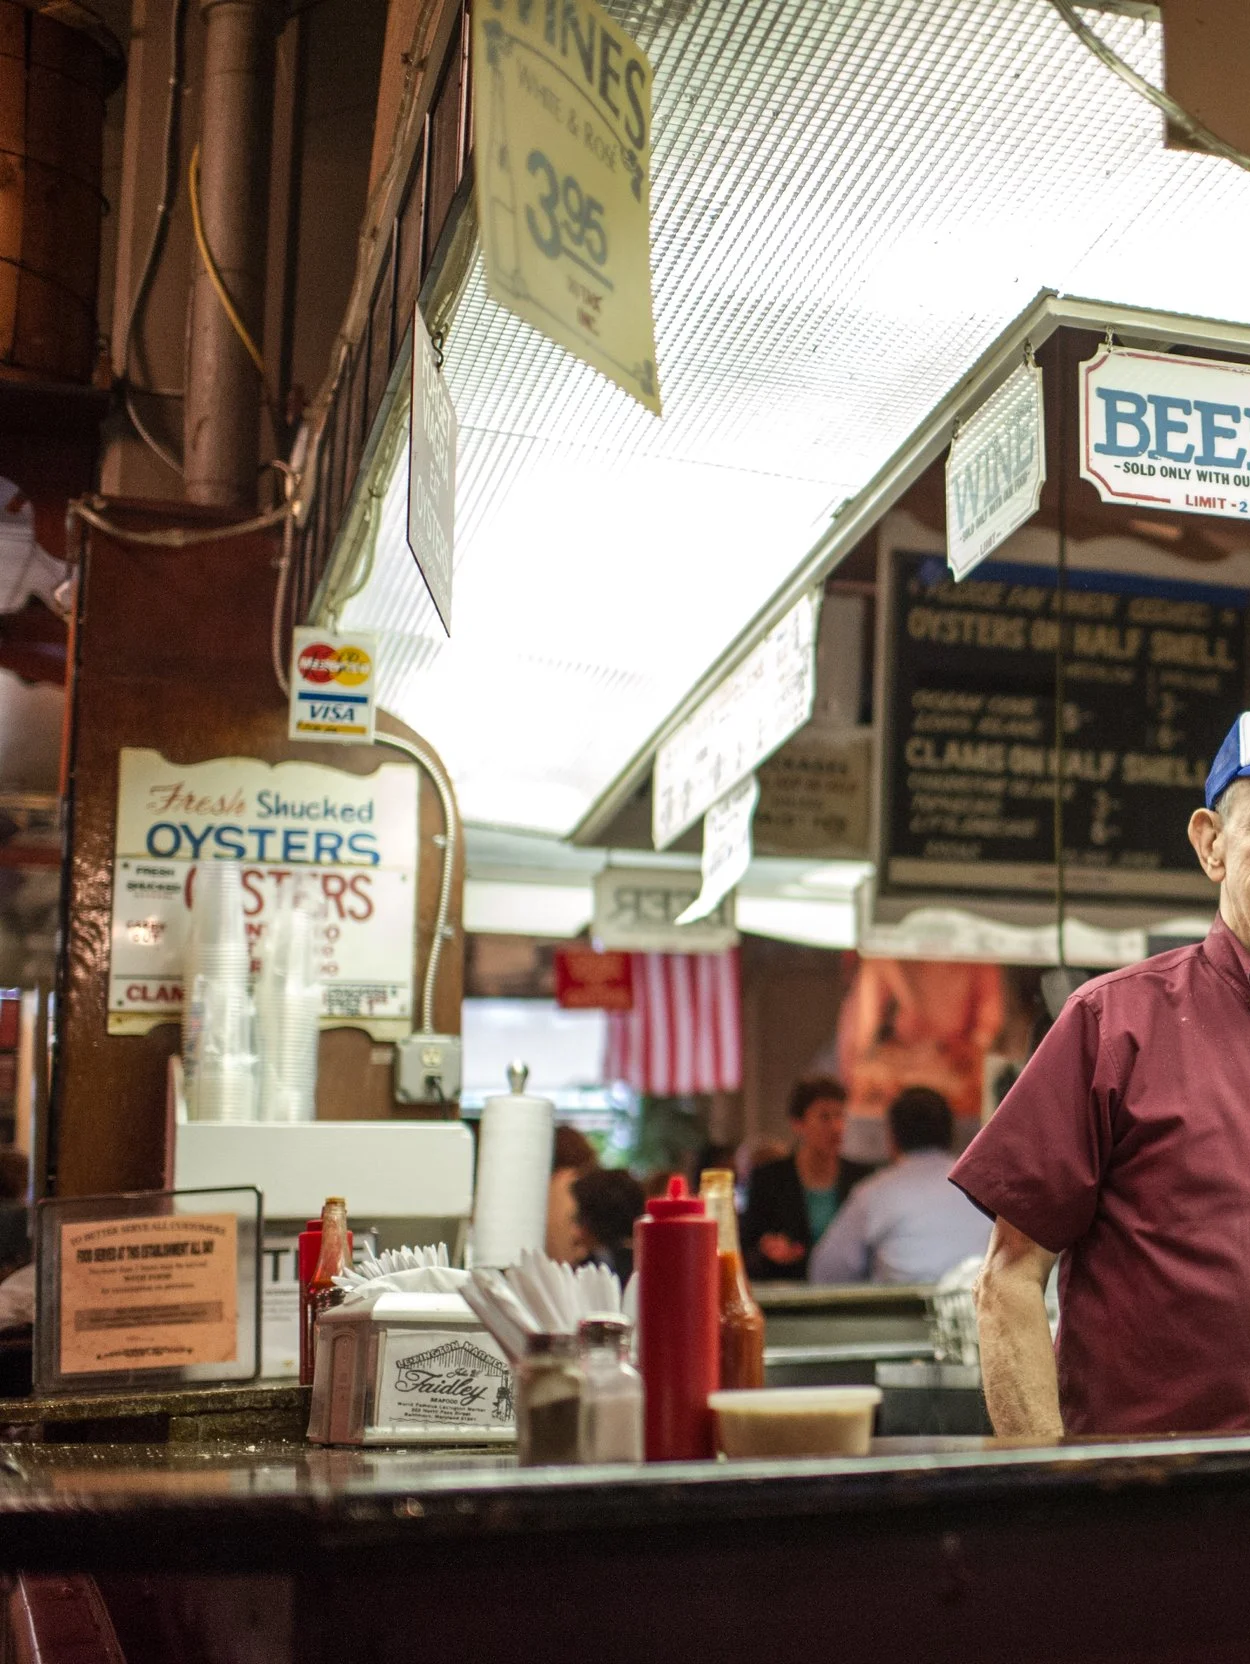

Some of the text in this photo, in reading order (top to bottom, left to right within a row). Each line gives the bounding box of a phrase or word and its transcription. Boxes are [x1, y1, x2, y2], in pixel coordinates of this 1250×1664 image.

[489, 0, 646, 151] INES
[1160, 466, 1191, 481] ONLY
[1196, 470, 1230, 485] WITH
[1185, 494, 1227, 510] LIMIT
[907, 607, 1027, 650] OYSTERS
[1072, 623, 1140, 662] HALF
[1150, 629, 1237, 671] SHELL
[310, 704, 354, 722] VISA
[906, 739, 1006, 772] CLAMS
[147, 780, 375, 822] Fresh Shucked
[146, 822, 381, 867] OYSTERS
[395, 1340, 459, 1369] LEXINGTON
[395, 1369, 488, 1406] Faidley
